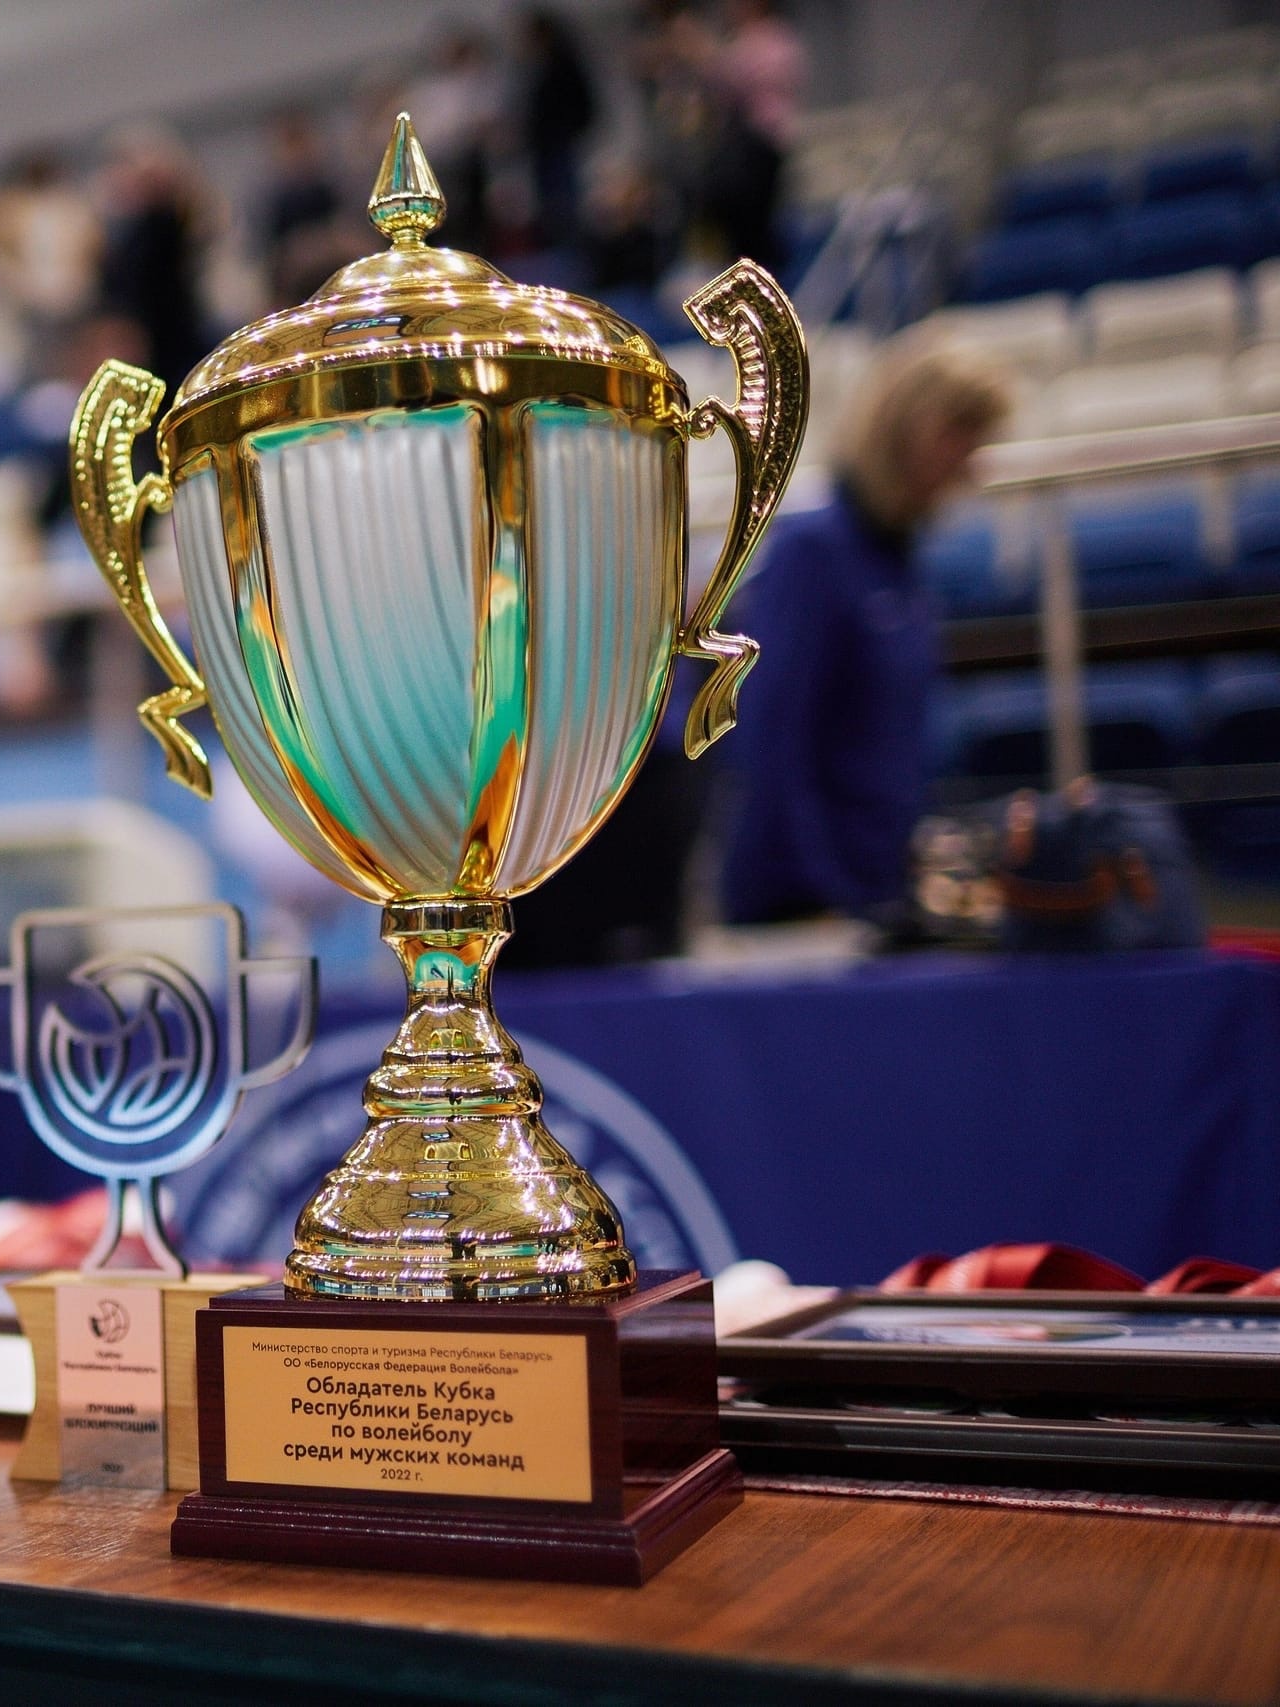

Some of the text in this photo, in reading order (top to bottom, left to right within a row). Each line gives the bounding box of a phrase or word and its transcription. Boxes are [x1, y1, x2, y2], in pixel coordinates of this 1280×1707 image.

[252, 1342, 328, 1357] Министерство
[331, 1346, 369, 1359] спорта
[382, 1348, 427, 1359] туризма
[430, 1348, 496, 1361] Республики
[499, 1350, 553, 1363] Беларусь
[283, 1358, 519, 1376] ОО «Белорусская Федерация Волейбола»
[306, 1377, 495, 1403] Обладатель Кубка
[291, 1399, 514, 1426] Республики Беларусь
[331, 1422, 472, 1448] по волейболу
[283, 1442, 524, 1472] среди мужских команд
[381, 1469, 423, 1481] 2022 г.
